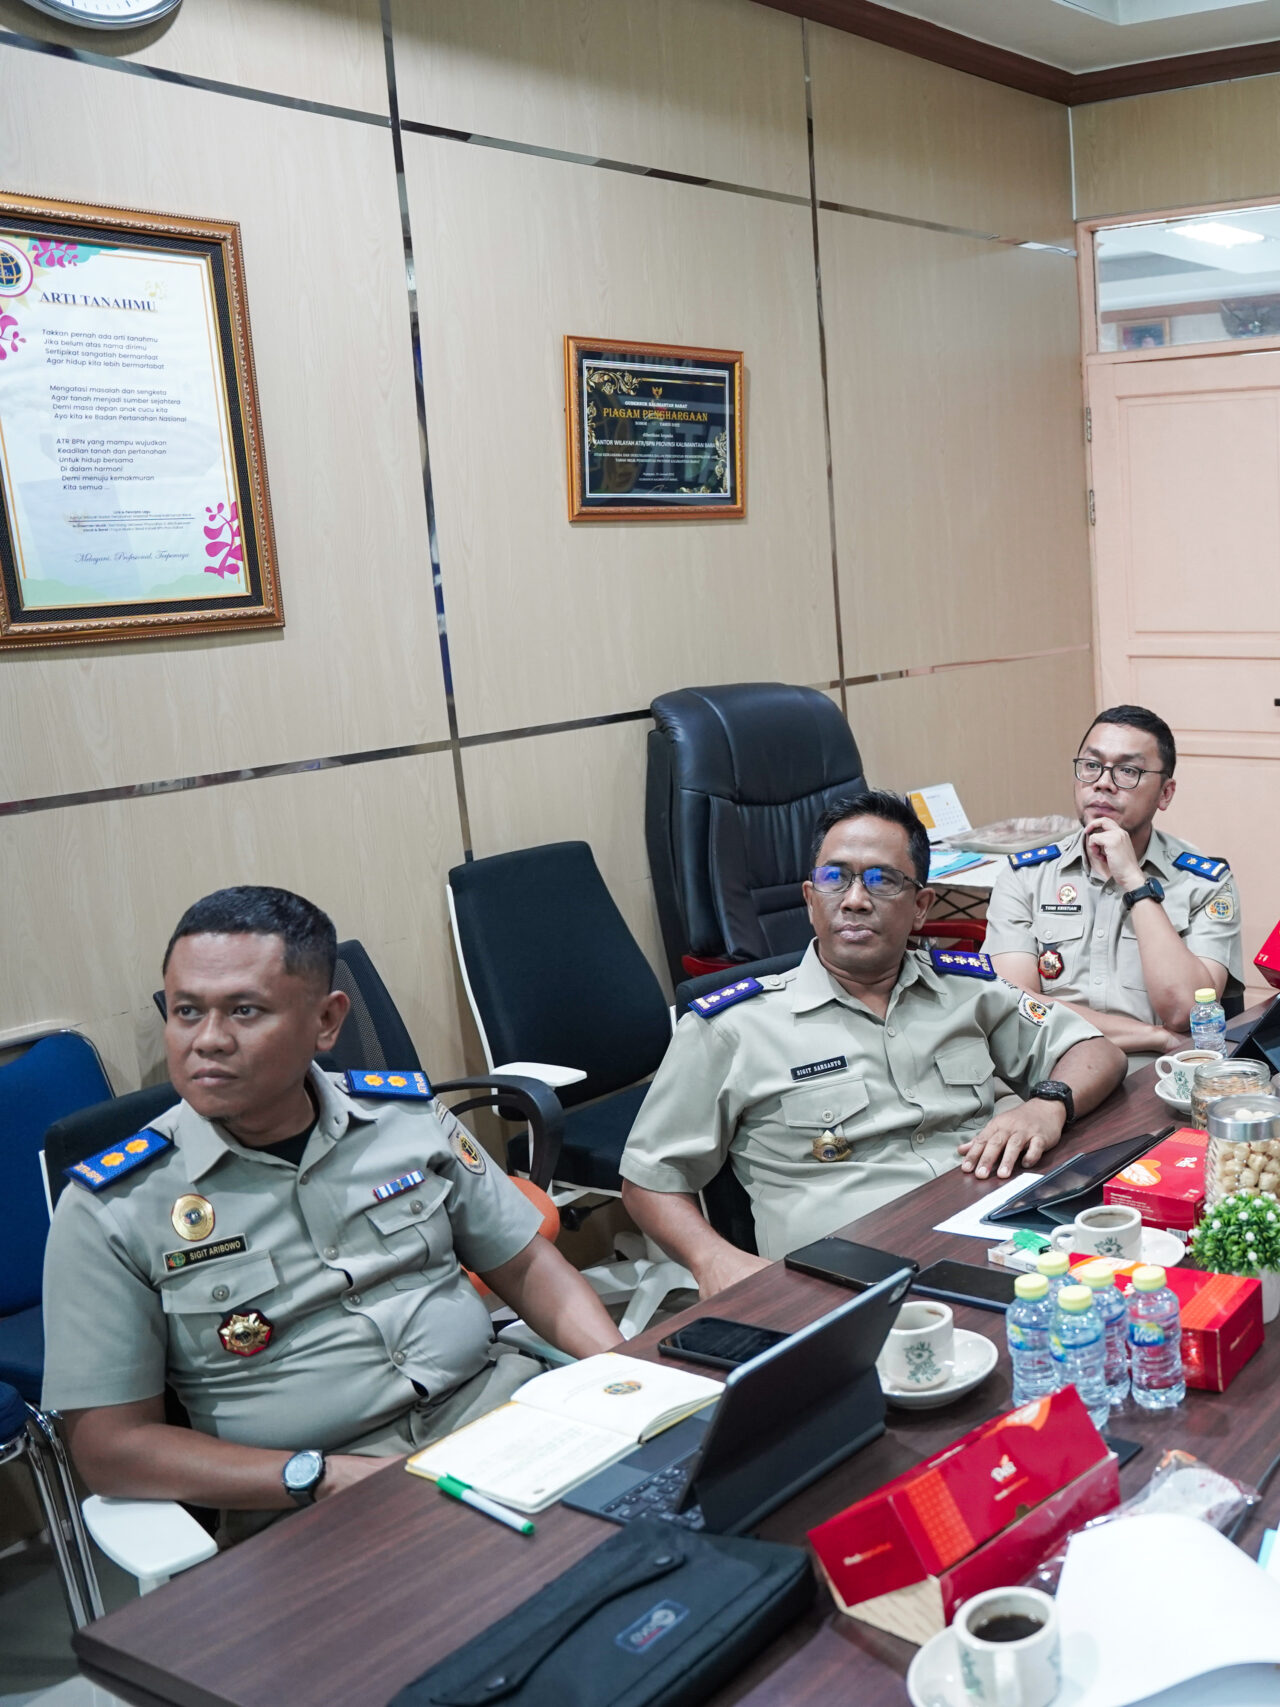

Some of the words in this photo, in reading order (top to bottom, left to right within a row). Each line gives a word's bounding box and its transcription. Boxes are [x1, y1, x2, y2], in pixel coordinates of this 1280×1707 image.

[40, 292, 76, 305] ARTI
[80, 295, 157, 312] TANAHMU
[42, 329, 69, 337] Takkan
[71, 331, 97, 339] pernah
[127, 335, 158, 343] tanahmu
[46, 358, 64, 366] Agar
[66, 358, 87, 366] hidup
[88, 359, 102, 367] kita
[122, 362, 165, 370] bermartabat
[603, 408, 640, 418] PIAGAM
[642, 409, 708, 421] PENGHARGAAN
[796, 1067, 811, 1076] SIGIT
[813, 1060, 841, 1072] SARSANTO
[190, 1249, 207, 1260] SIGIT
[209, 1241, 241, 1255] ARIBOWO
